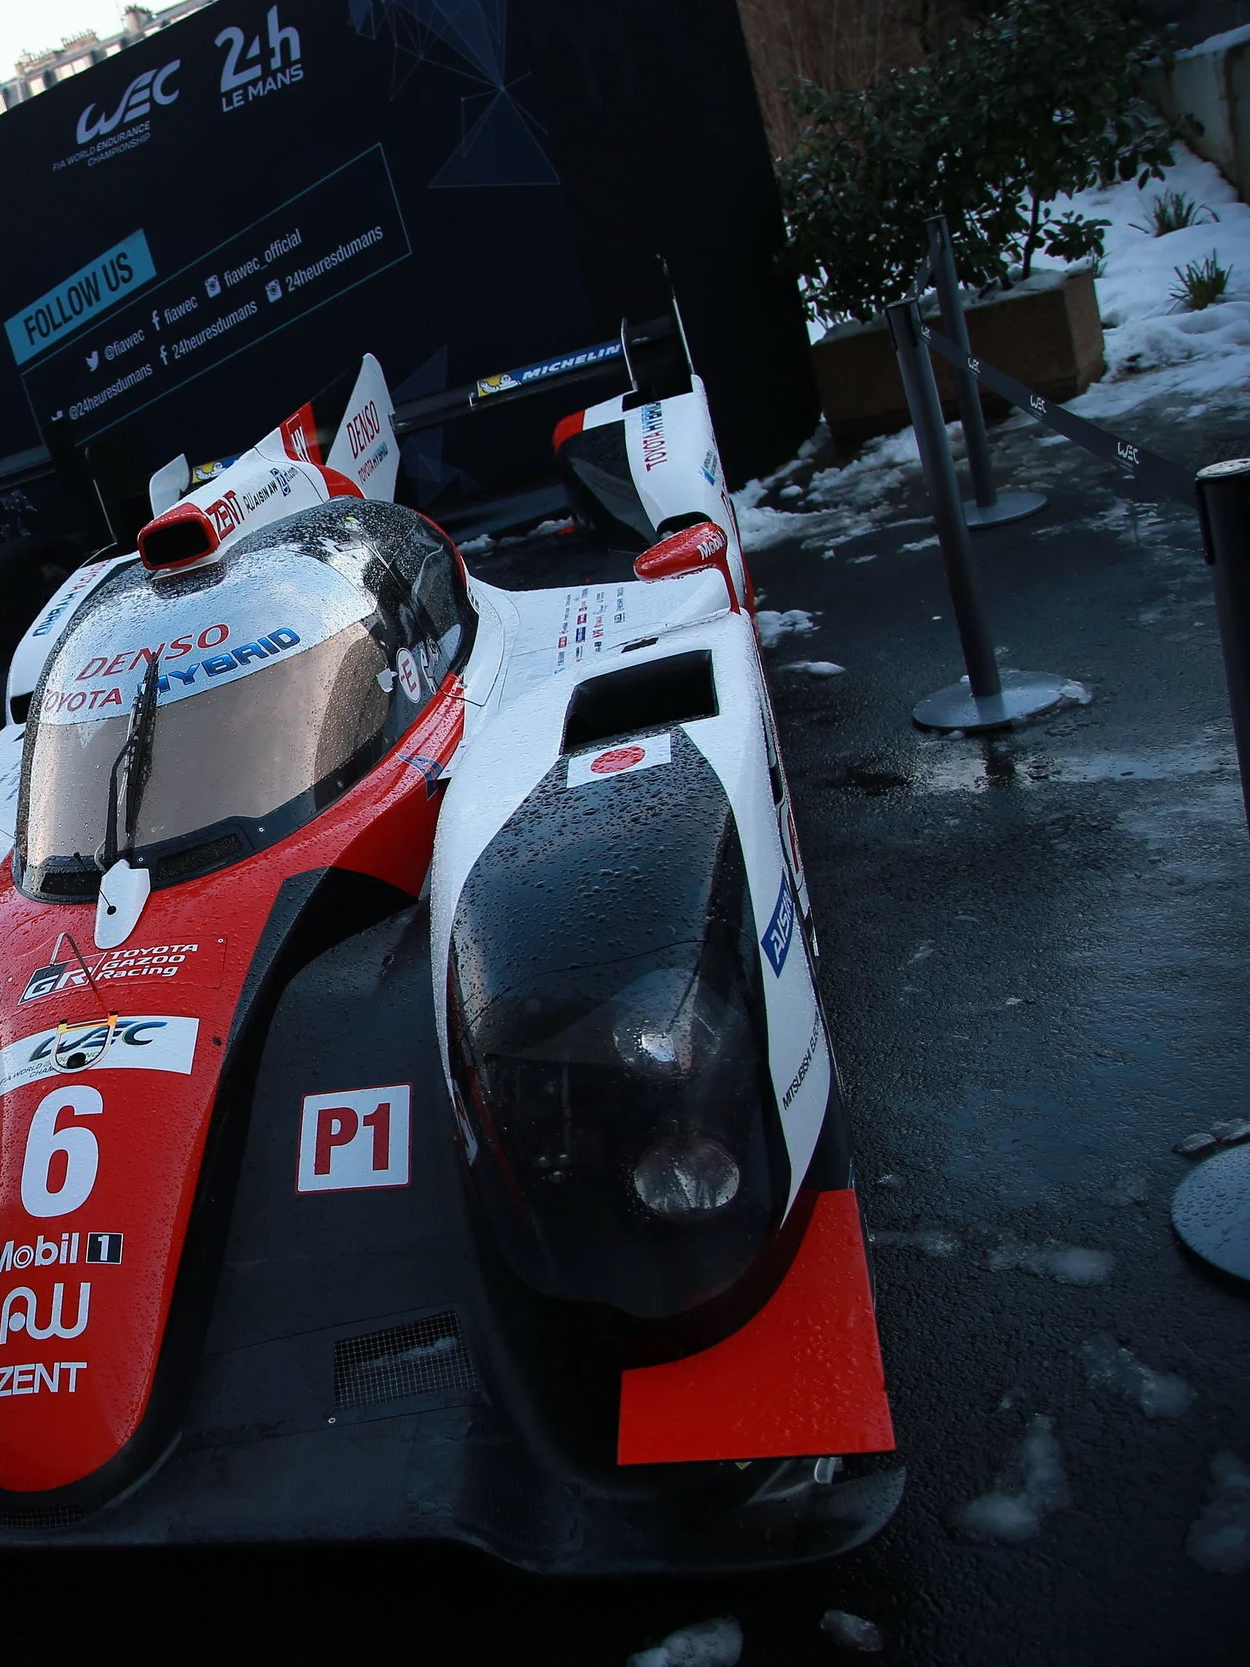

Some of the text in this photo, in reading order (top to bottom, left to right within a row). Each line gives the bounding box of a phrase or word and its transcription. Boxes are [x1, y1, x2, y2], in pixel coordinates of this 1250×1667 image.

[214, 5, 301, 93] 24h
[76, 60, 181, 144] WEC
[222, 64, 304, 112] LE MANS
[67, 146, 96, 166] WORLD
[96, 120, 151, 152] ENDURANCE
[87, 132, 151, 167] CHAMPIONSHIP
[23, 252, 134, 346] FOLLOW US
[104, 330, 146, 361] @fiawec
[164, 296, 198, 325] fiawec
[224, 228, 302, 288] fiawec_official
[68, 363, 153, 421] @24heuresdumans
[172, 301, 258, 360] 24heuresdumans
[285, 225, 384, 292] 24heuresdumans
[522, 343, 622, 381] MICHELIN
[1030, 394, 1047, 414] WEC
[346, 400, 380, 460] DENSO
[642, 430, 668, 472] TOYOTA
[1117, 440, 1140, 465] WEC
[203, 490, 245, 540] ZENT
[75, 623, 231, 682] DENSO
[95, 965, 179, 982] Racing
[101, 954, 186, 971] GAZOO
[110, 943, 199, 960] TOYOTA
[27, 1020, 168, 1063] WEC
[13, 1062, 43, 1079] WORLD
[20, 1085, 105, 1219] 6
[313, 1102, 393, 1175] P1
